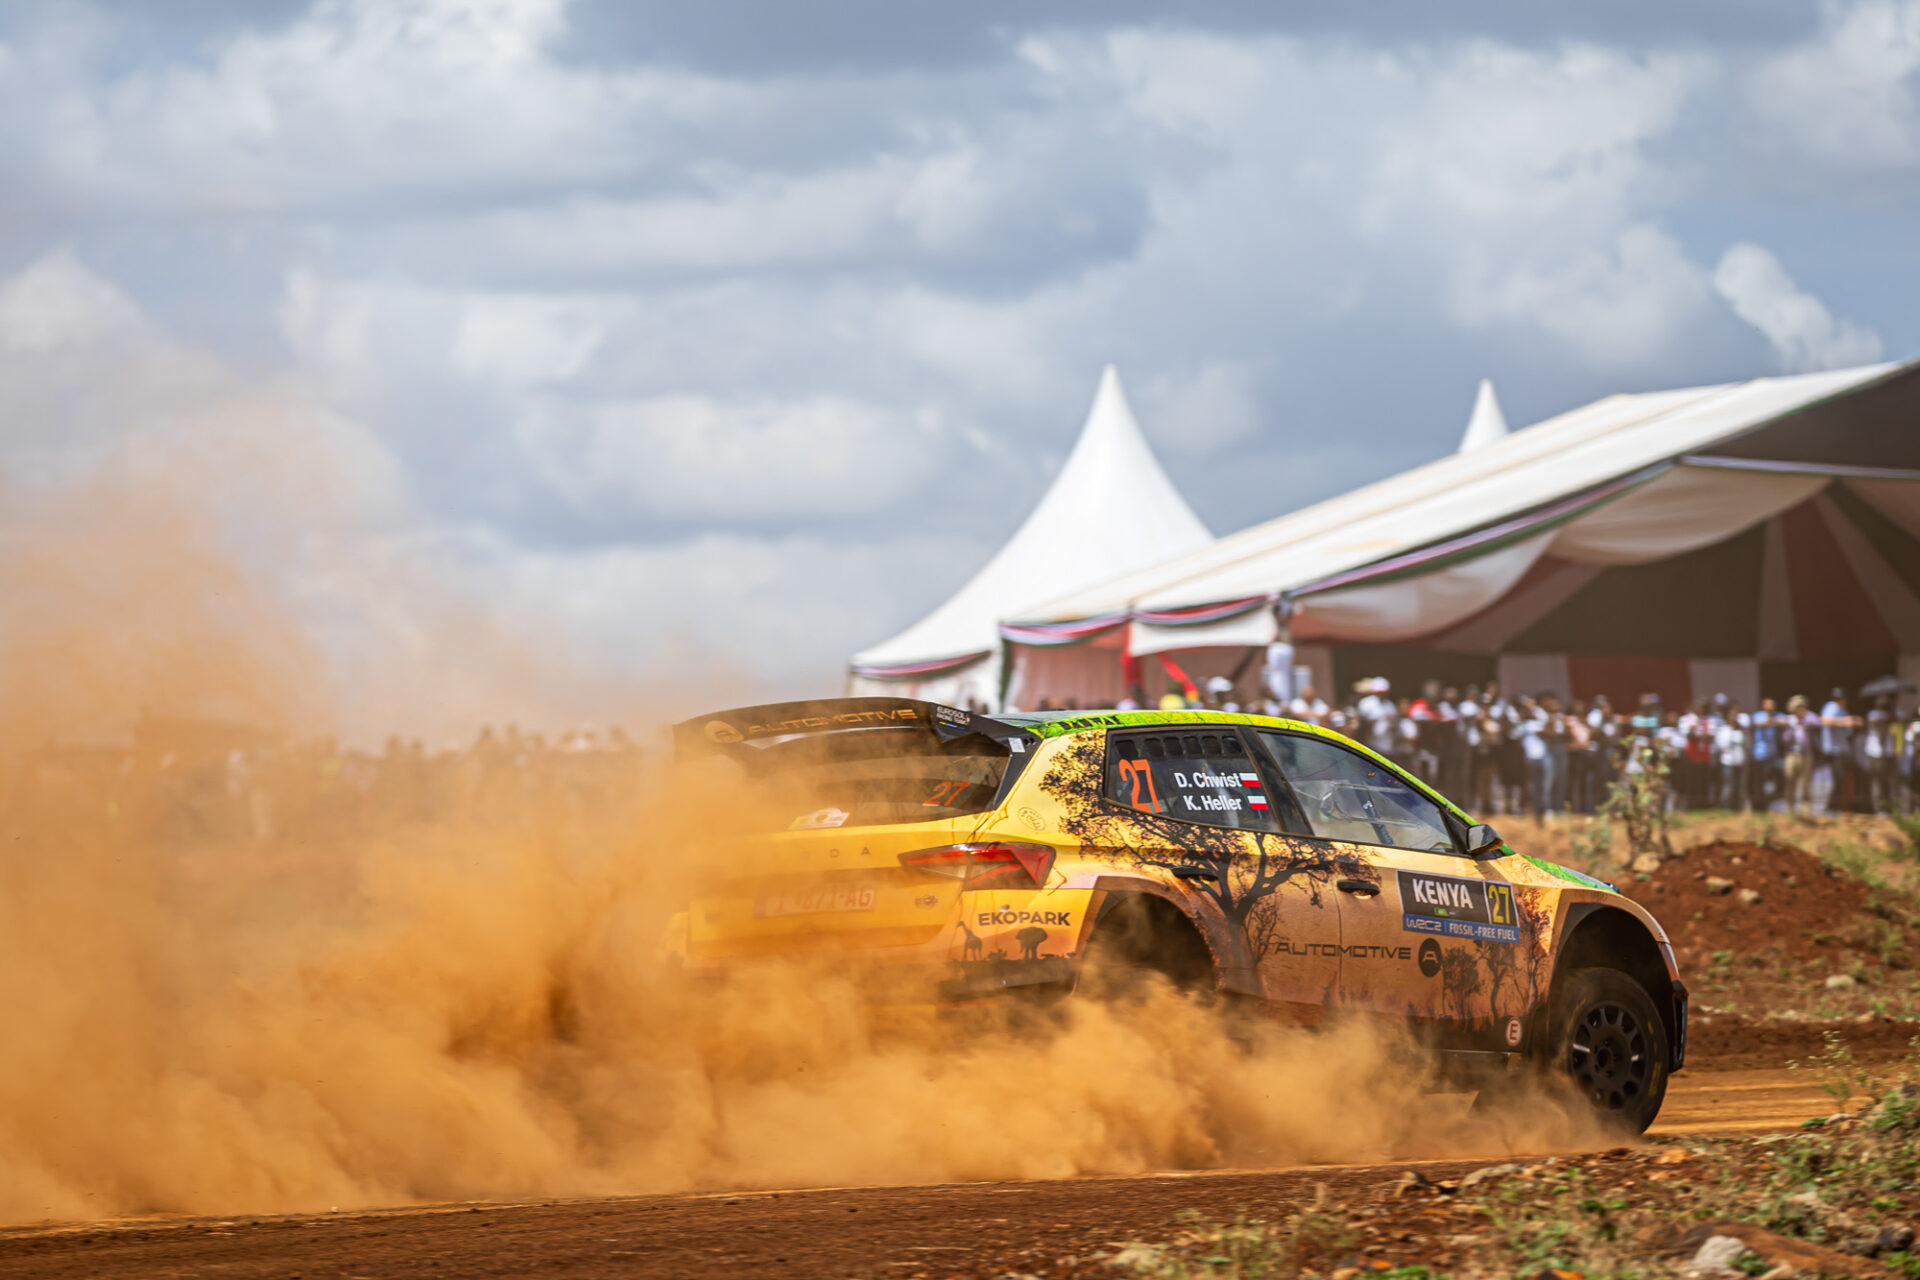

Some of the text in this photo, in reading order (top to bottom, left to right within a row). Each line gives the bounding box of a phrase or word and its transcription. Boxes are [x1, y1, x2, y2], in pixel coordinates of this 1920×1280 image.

[749, 708, 918, 733] AUTOMOTIVE
[1118, 758, 1163, 813] 27
[1173, 772, 1243, 788] D. Chwist
[922, 781, 971, 807] 27
[1183, 795, 1243, 811] K. Heller
[1412, 878, 1474, 909] KENYA
[1488, 884, 1511, 925] 27
[978, 911, 1071, 926] EKOPARK
[1406, 917, 1443, 932] WRC2
[1448, 922, 1517, 941] FOSSIL-FREE FUEL
[1275, 942, 1412, 959] AUTOMOTIVE
[1508, 1023, 1518, 1041] E
